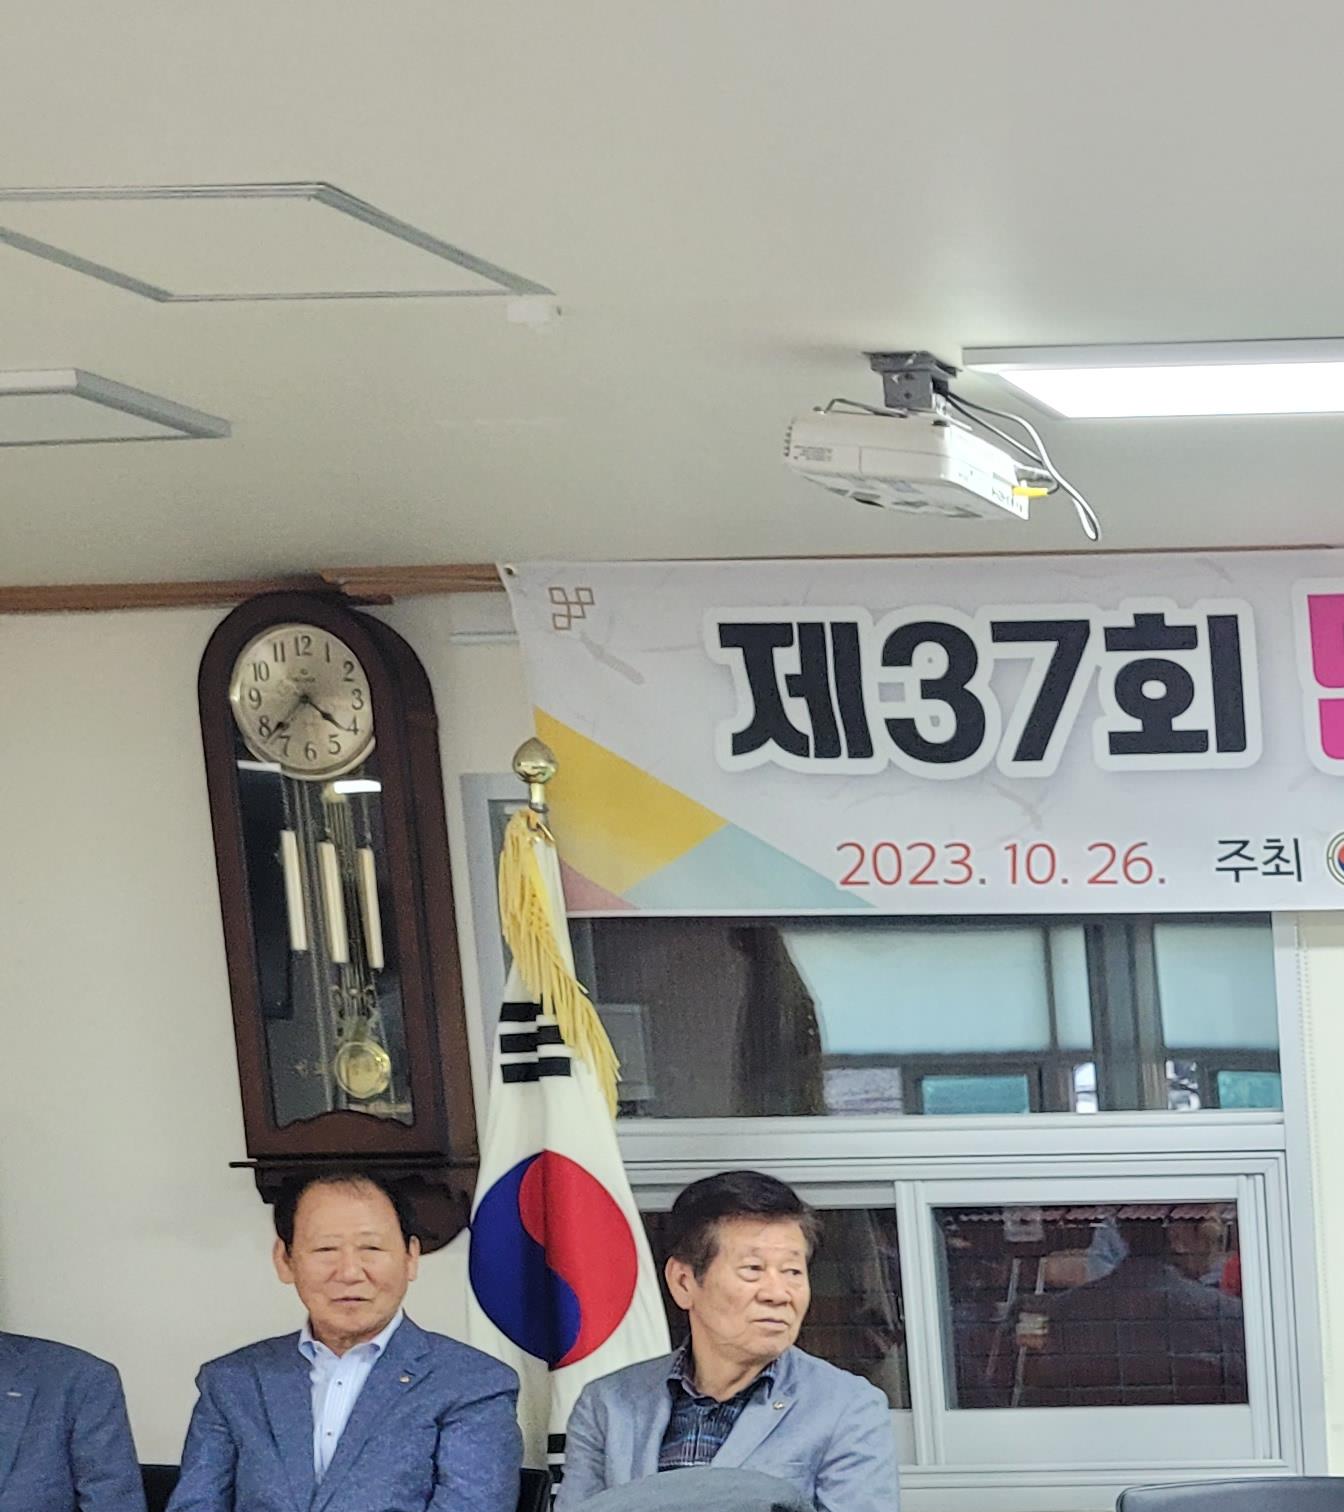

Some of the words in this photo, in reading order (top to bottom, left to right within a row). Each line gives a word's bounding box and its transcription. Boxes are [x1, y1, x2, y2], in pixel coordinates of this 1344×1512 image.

[273, 641, 286, 663] 11
[294, 635, 313, 657] 12
[325, 643, 331, 664] 1
[252, 661, 270, 683] 10
[343, 660, 355, 683] 2
[248, 688, 262, 711] 9
[351, 688, 364, 711] 3
[717, 612, 1248, 765] 제37회
[258, 715, 272, 739] 8
[348, 716, 359, 736] 4
[277, 734, 291, 758] 7
[305, 741, 318, 762] 6
[328, 734, 342, 756] 5
[836, 842, 986, 885] 2023.
[1004, 842, 1069, 885] 10.
[1087, 842, 1167, 885] 26.
[1215, 838, 1303, 884] 주최
